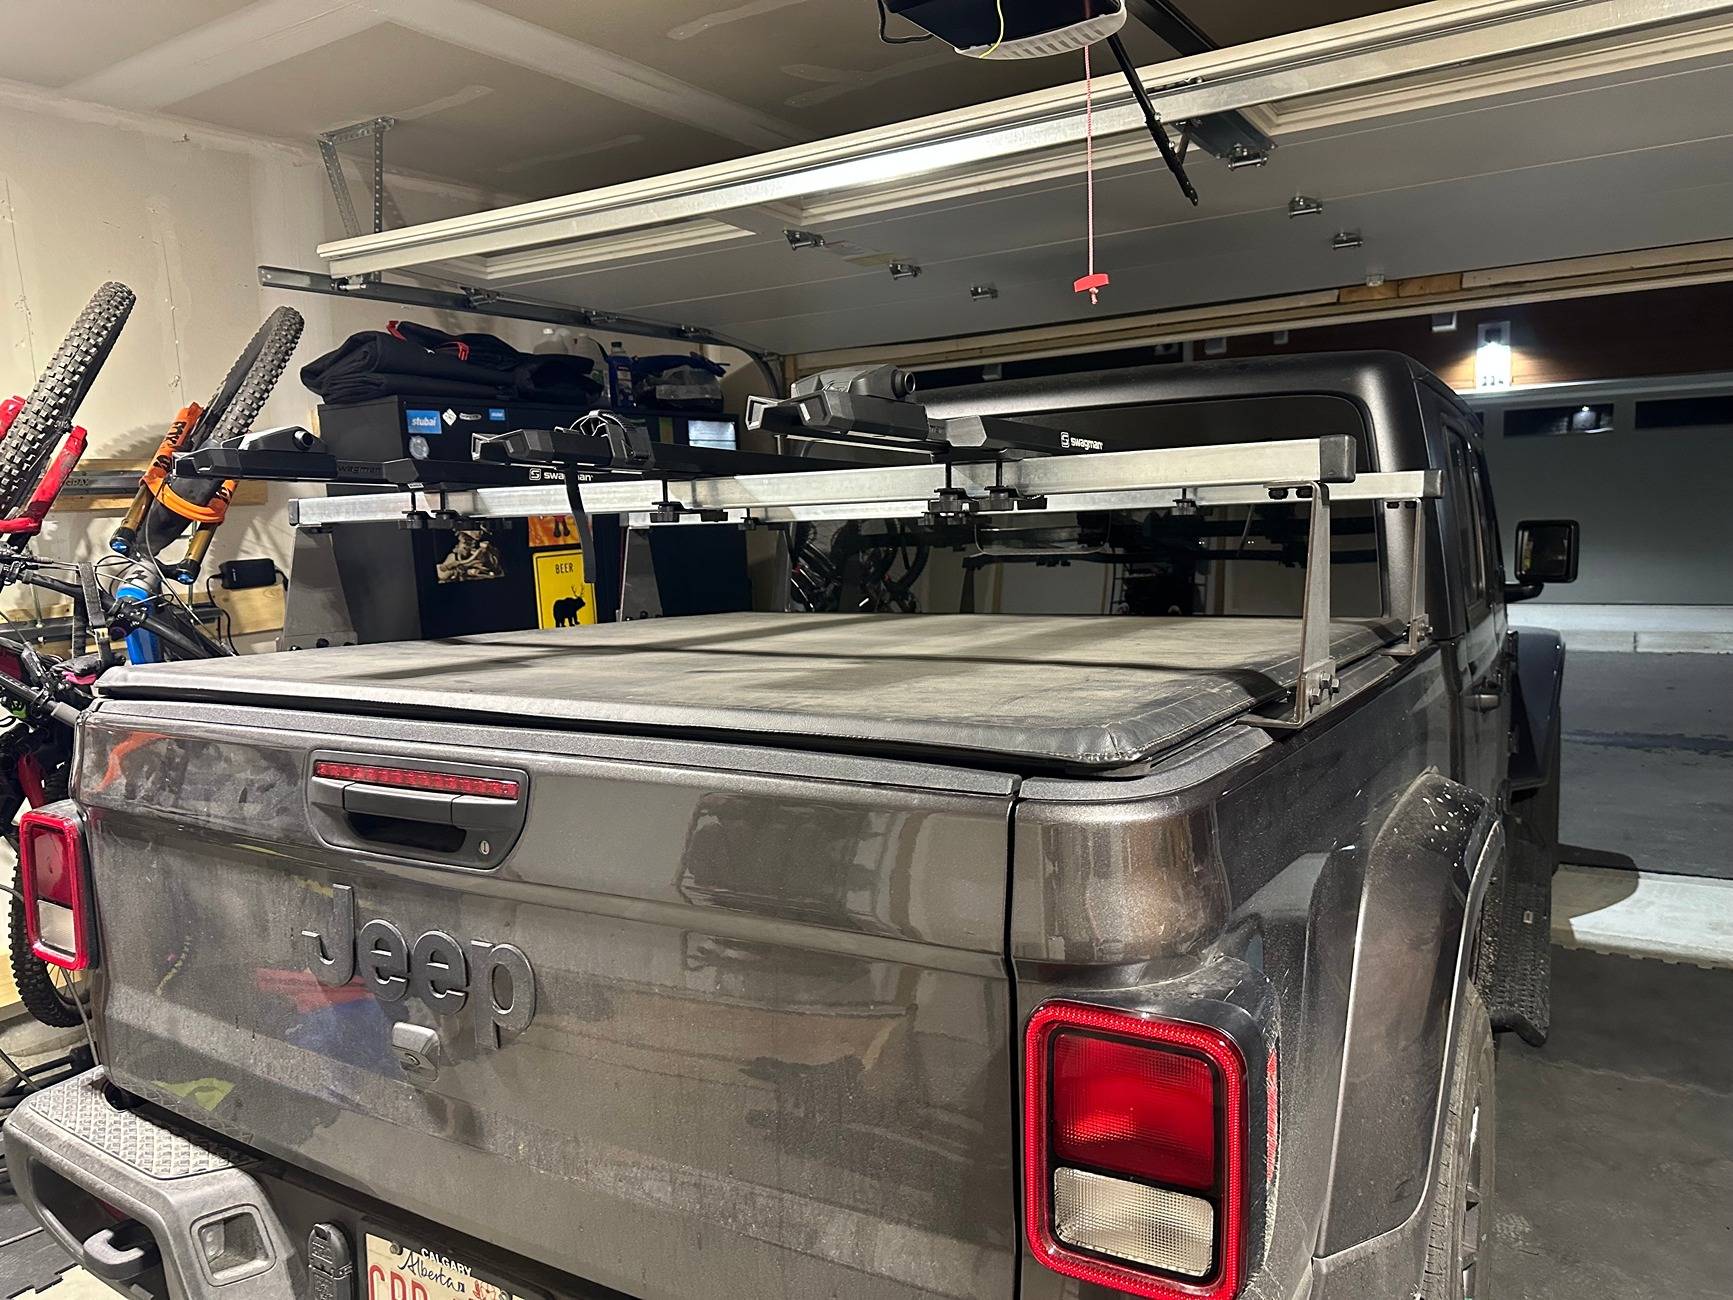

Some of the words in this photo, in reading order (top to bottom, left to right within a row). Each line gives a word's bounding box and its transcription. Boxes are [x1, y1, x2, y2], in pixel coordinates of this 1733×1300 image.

[1070, 437, 1103, 450] swagman
[543, 471, 592, 482] swaan
[555, 562, 574, 574] BEER
[301, 884, 536, 1050] Jeep
[397, 1252, 461, 1292] Alberta
[420, 1247, 473, 1277] CALGARY
